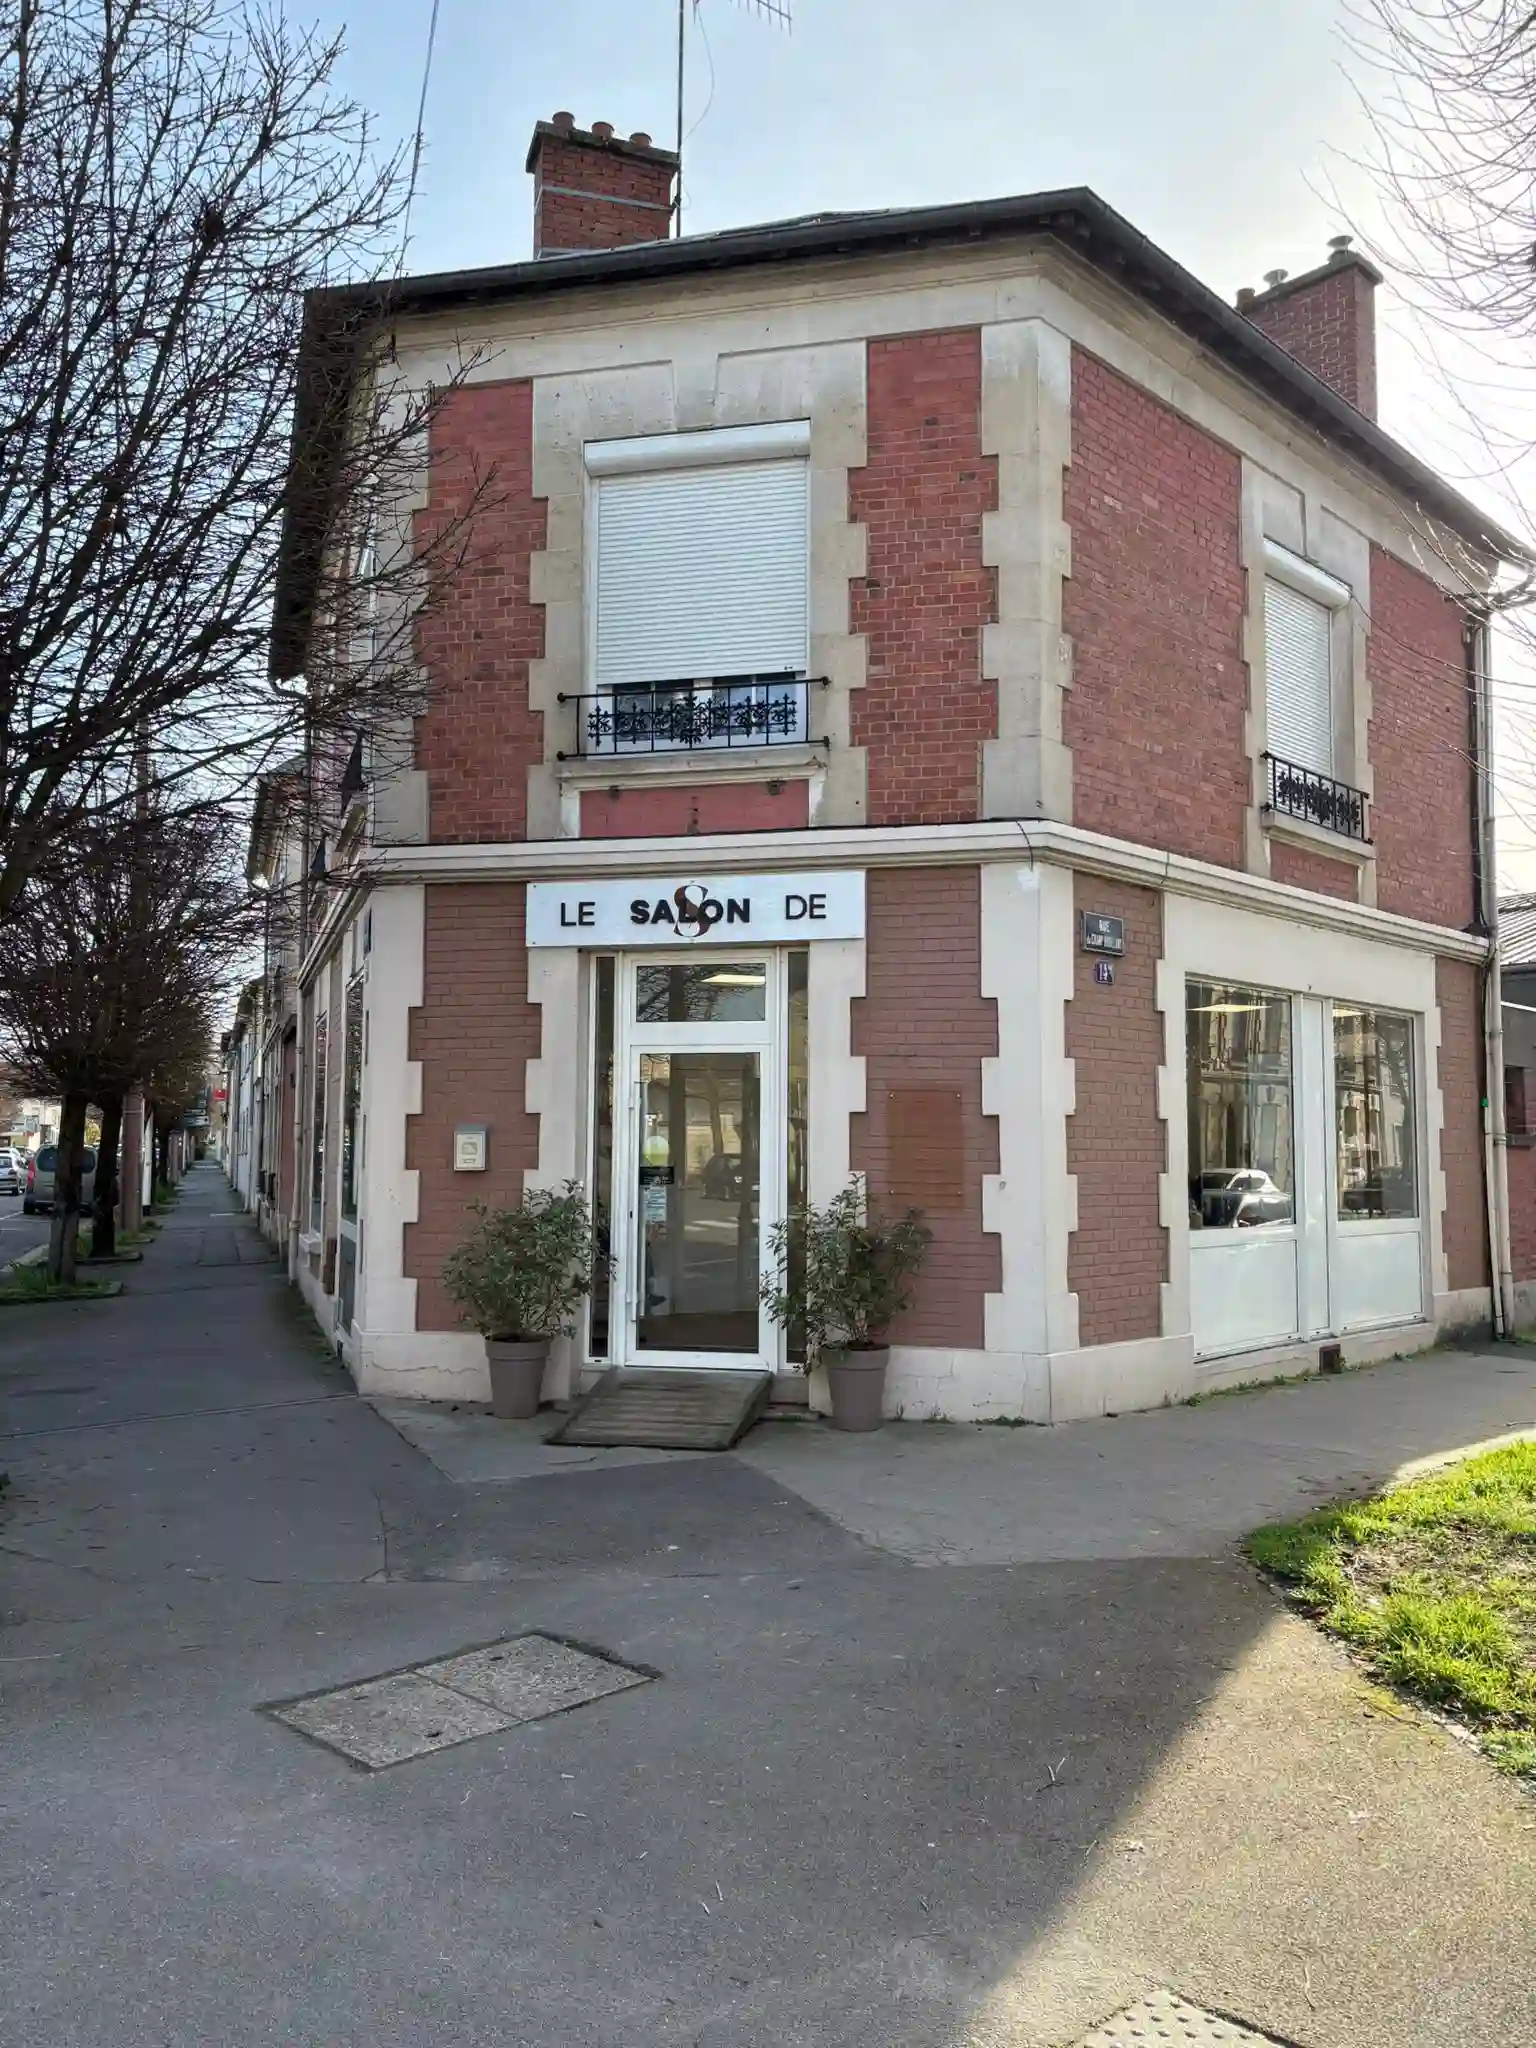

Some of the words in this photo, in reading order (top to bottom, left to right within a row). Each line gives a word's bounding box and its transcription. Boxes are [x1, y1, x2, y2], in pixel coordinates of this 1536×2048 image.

[560, 901, 596, 927] LE
[630, 898, 751, 925] SALON
[785, 893, 827, 920] DE
